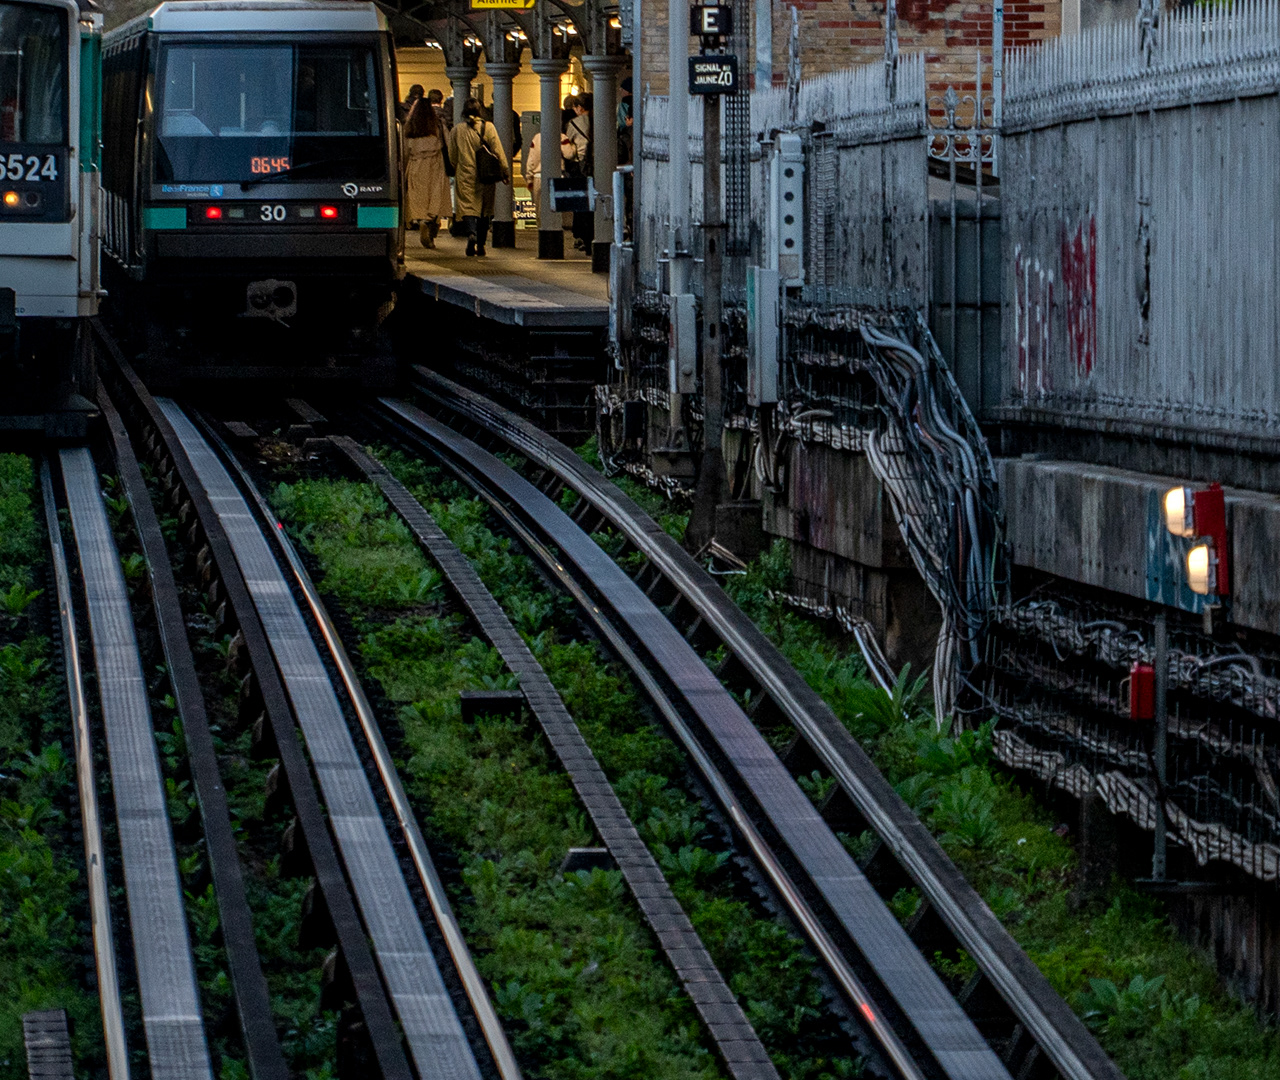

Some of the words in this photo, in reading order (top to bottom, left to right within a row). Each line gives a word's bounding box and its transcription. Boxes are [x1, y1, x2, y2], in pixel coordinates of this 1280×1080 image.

[702, 7, 719, 32] E
[694, 63, 721, 72] SIGNAL
[694, 74, 718, 85] JAUNE
[718, 71, 733, 86] 40
[251, 157, 291, 174] 0645
[260, 205, 287, 221] 30
